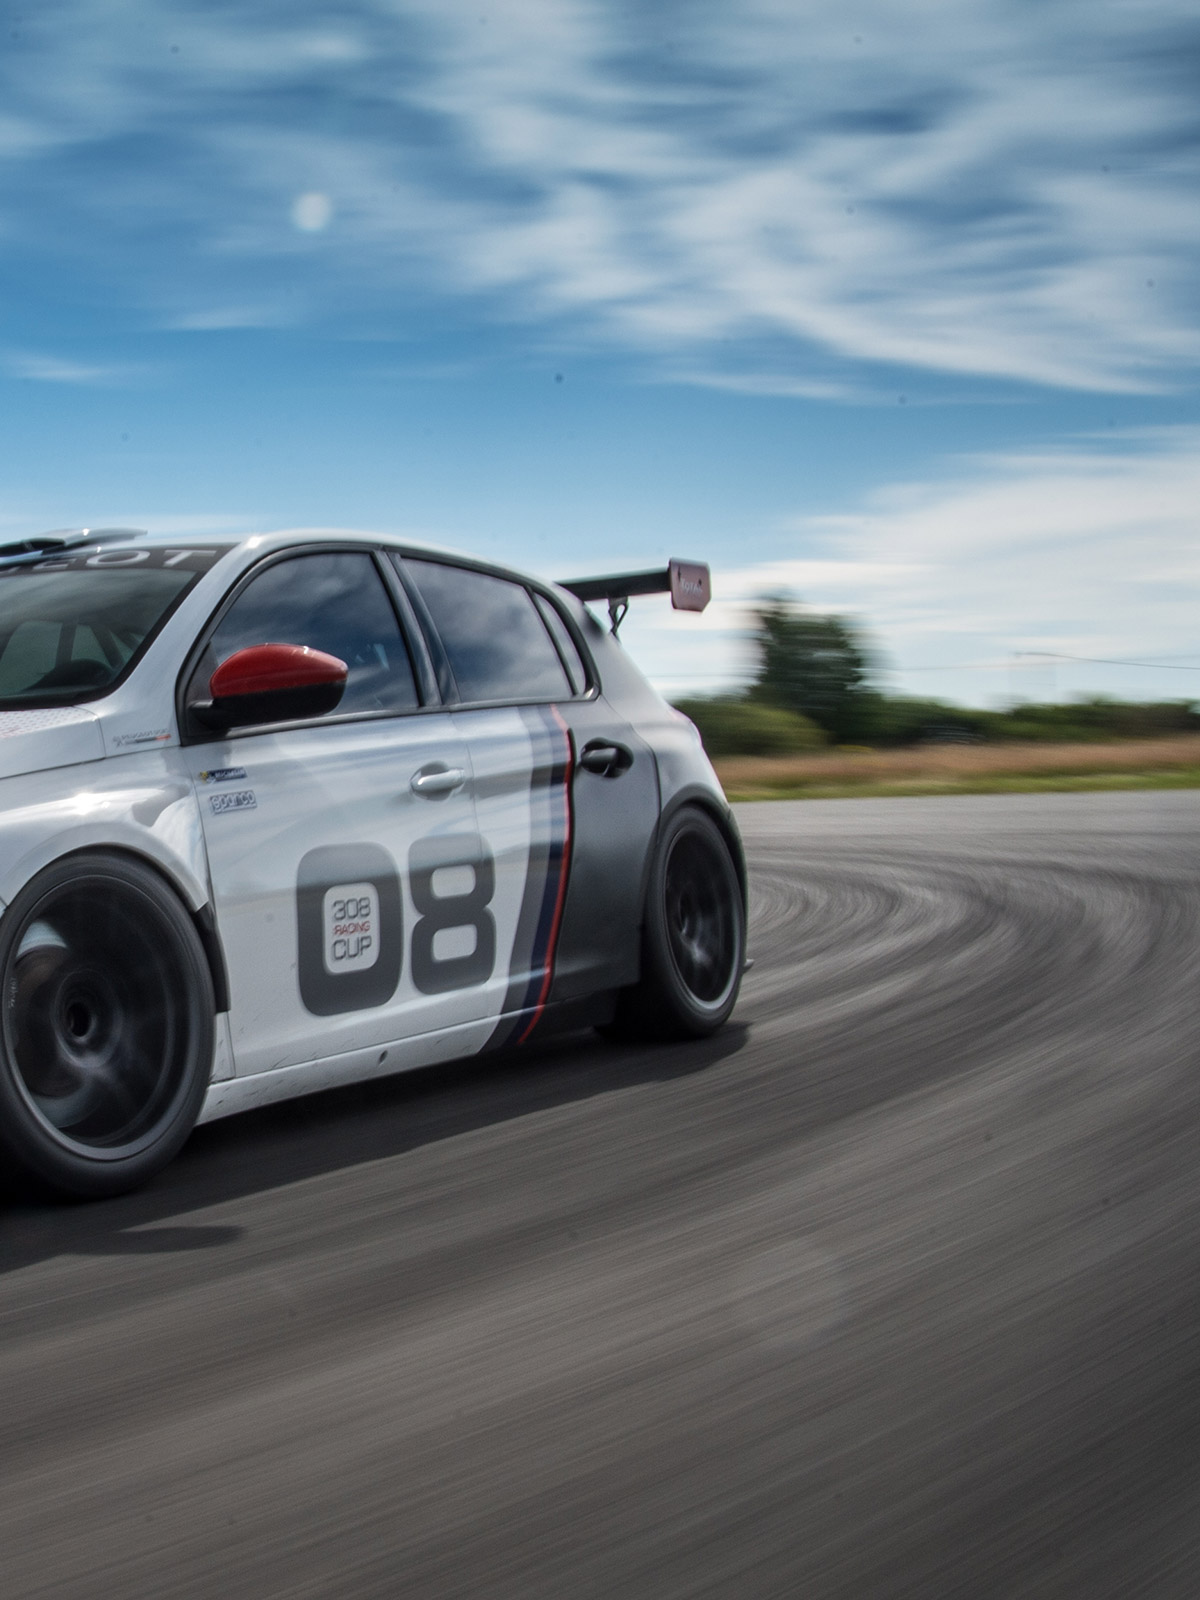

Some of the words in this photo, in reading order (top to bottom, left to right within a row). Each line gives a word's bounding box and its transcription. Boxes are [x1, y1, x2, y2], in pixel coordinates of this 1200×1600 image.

[333, 897, 371, 920] 308
[296, 832, 497, 1017] 08
[334, 920, 371, 935] RACING
[333, 936, 372, 960] CUP
